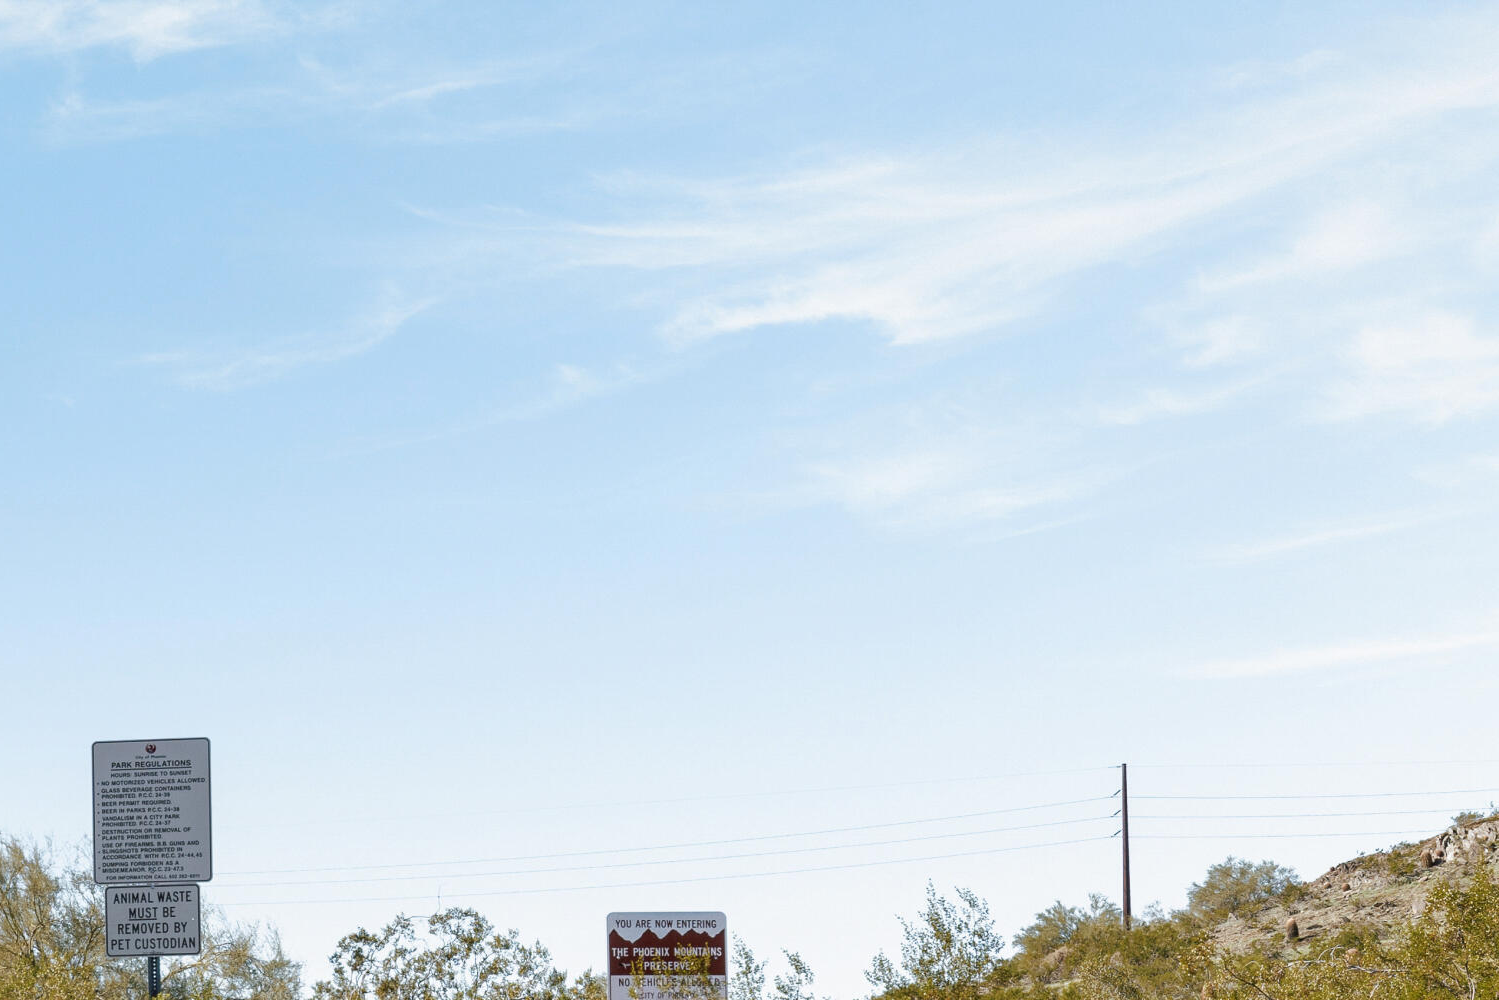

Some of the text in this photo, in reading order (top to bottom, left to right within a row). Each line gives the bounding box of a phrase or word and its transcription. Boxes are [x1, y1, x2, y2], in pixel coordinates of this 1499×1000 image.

[113, 891, 192, 904] ANIMAL WASTE
[128, 907, 176, 918] MUST BE
[118, 922, 188, 934] REMOVED BY
[616, 920, 717, 928] YOU ARE NOW ENTERING
[111, 937, 195, 950] PET CUSTODIAN
[612, 947, 722, 957] THE PHOENIX MOUNTAINS
[644, 962, 691, 970] PRESERVE
[619, 978, 630, 986] NO
[637, 978, 677, 986] EHICLES
